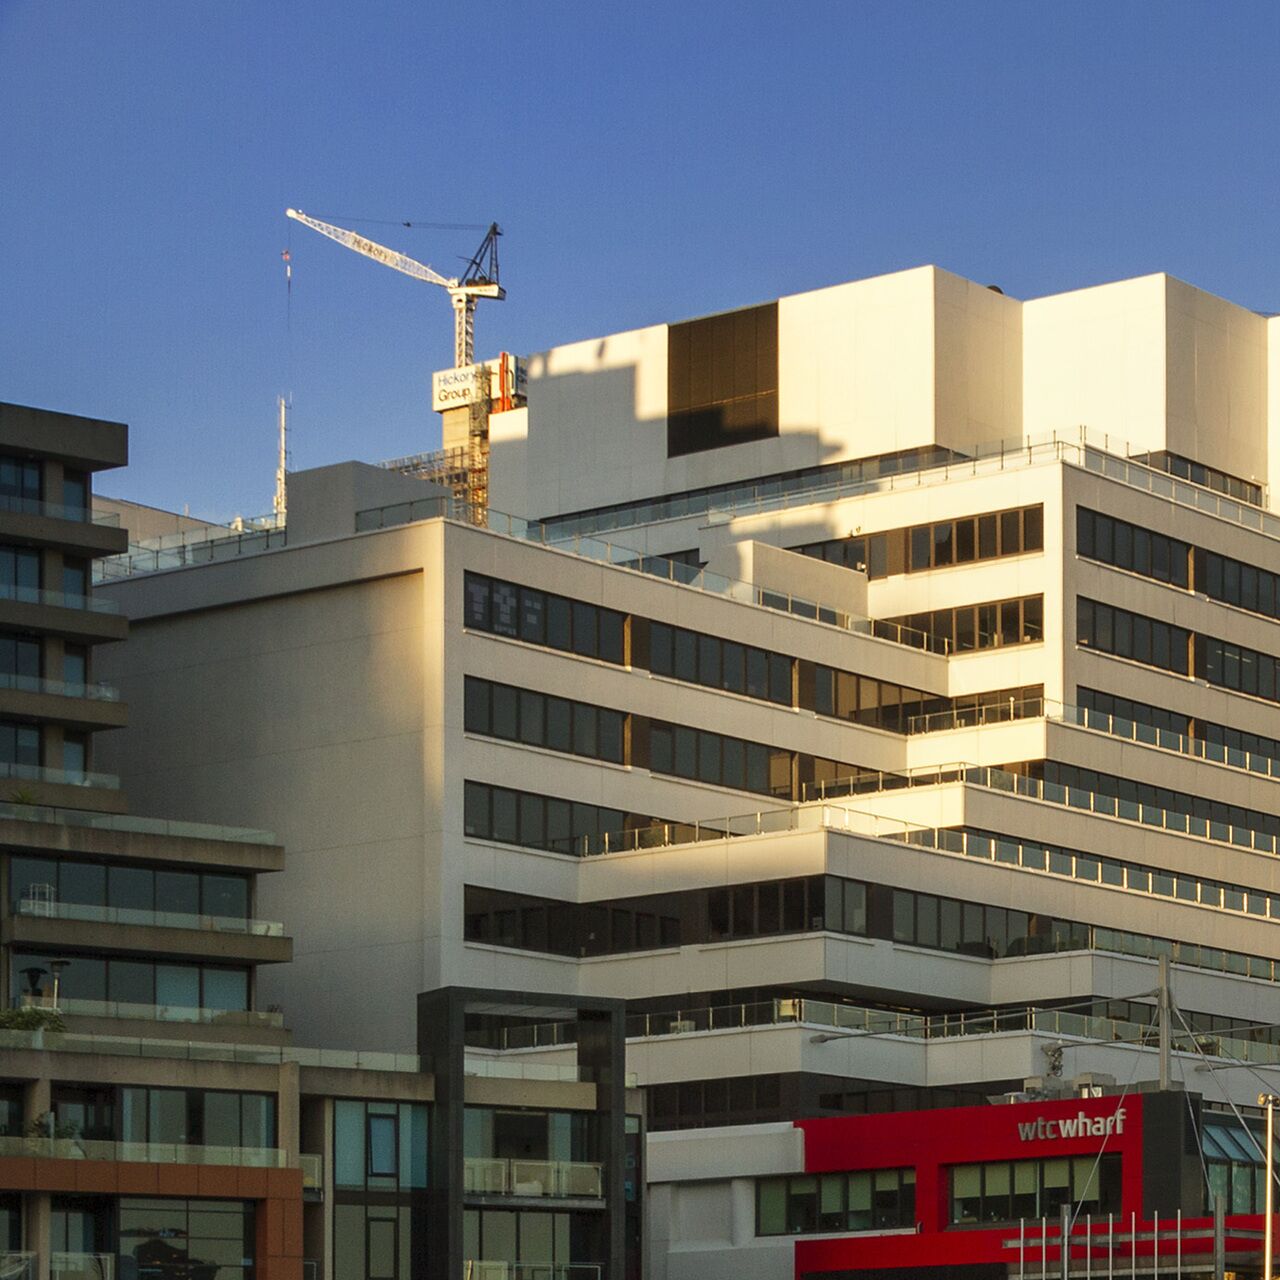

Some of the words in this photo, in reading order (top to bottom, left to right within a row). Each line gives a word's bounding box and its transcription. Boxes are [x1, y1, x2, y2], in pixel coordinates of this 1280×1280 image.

[352, 236, 389, 262] Hickory
[438, 373, 475, 386] Hickory
[438, 388, 471, 402] Group
[1018, 1108, 1127, 1141] wtcwharf
